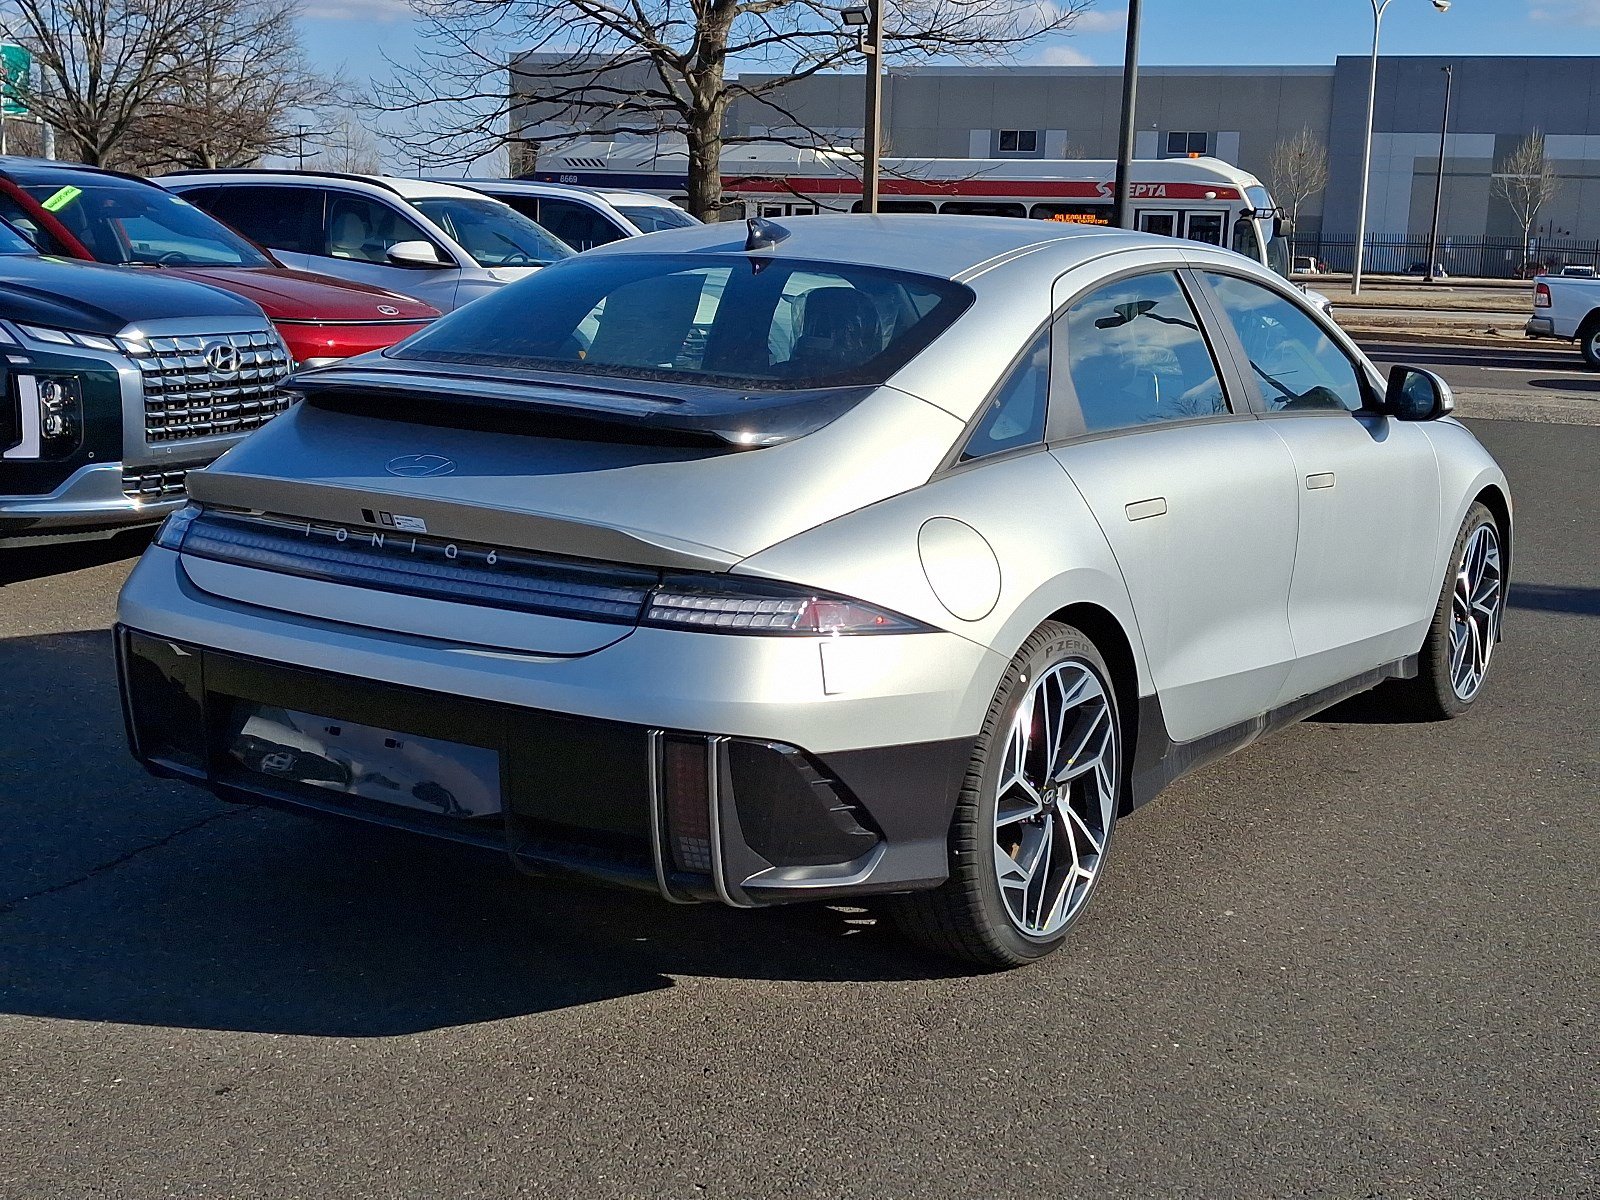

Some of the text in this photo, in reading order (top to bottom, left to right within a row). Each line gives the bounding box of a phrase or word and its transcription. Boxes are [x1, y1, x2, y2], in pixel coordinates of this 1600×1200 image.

[560, 174, 578, 183] 8669
[1128, 184, 1167, 197] EPTA
[305, 522, 458, 559] IONIQ
[486, 549, 497, 565] 6
[1045, 645, 1054, 659] P
[1057, 639, 1090, 653] ZERO
